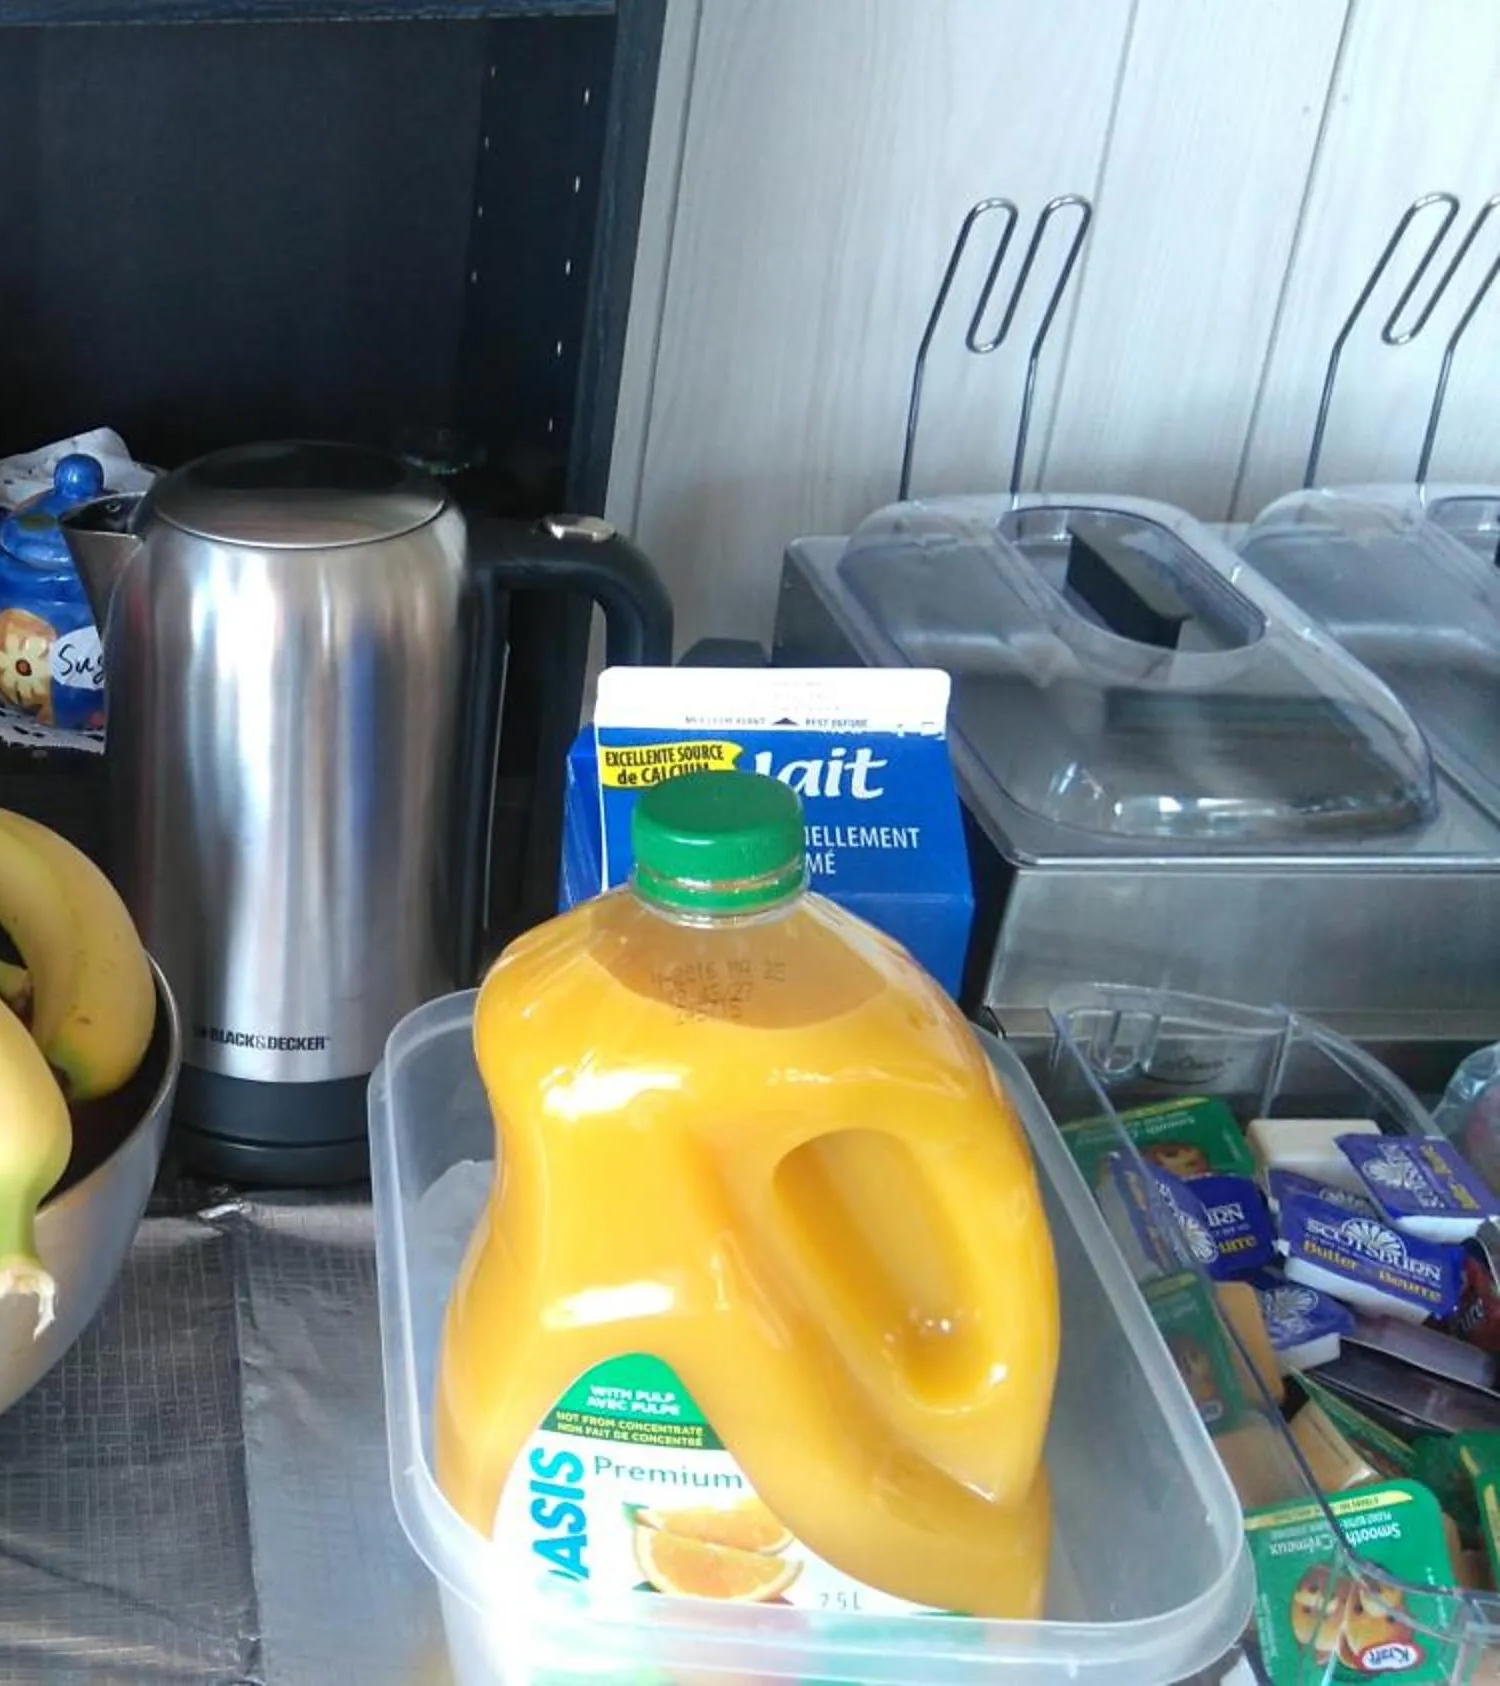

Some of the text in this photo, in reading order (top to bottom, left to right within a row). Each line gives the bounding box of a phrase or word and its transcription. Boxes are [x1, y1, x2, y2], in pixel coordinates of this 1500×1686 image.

[605, 744, 724, 767] EXCELLENTE SOURCE
[617, 769, 637, 785] de
[1303, 1239, 1358, 1271] Butter
[1306, 1217, 1442, 1282] SCOTSBURN
[556, 1411, 704, 1437] NOT FROM CONCENTRATE
[557, 1422, 583, 1434] NON
[585, 1426, 611, 1439] FAIT
[594, 1454, 743, 1490] Premium
[529, 1447, 591, 1585] ASIS
[1345, 1522, 1402, 1548] Smooth
[1367, 1644, 1411, 1667] Kraft
